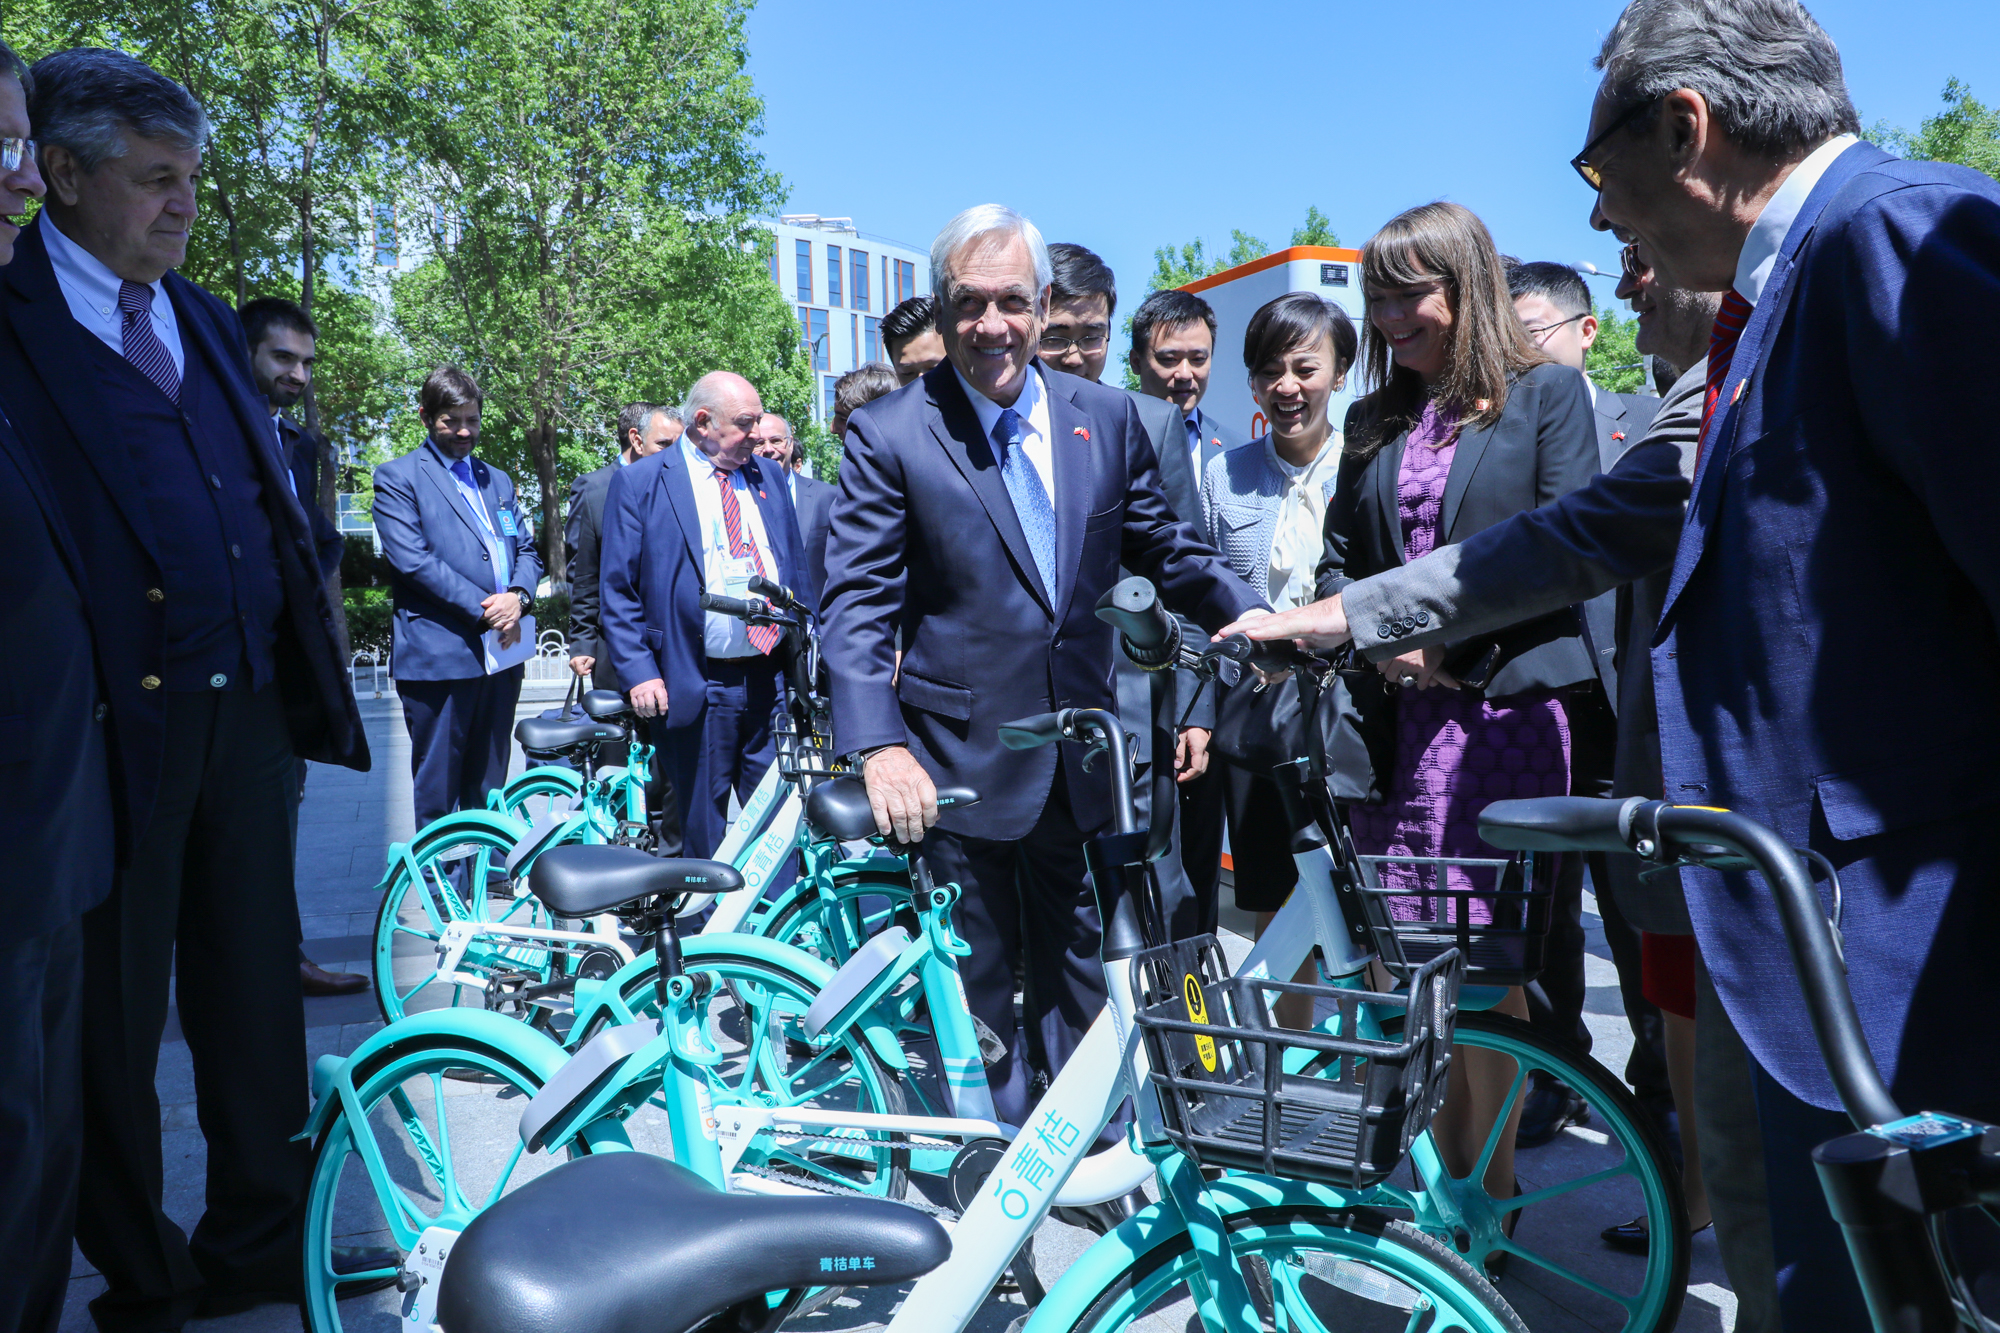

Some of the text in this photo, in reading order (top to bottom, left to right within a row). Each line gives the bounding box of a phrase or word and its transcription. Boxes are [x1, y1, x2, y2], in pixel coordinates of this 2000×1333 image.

[745, 788, 770, 820] 青桔
[752, 832, 785, 872] 青桔
[1010, 1109, 1080, 1191] 青桔
[819, 1256, 876, 1272] 青桔单车
